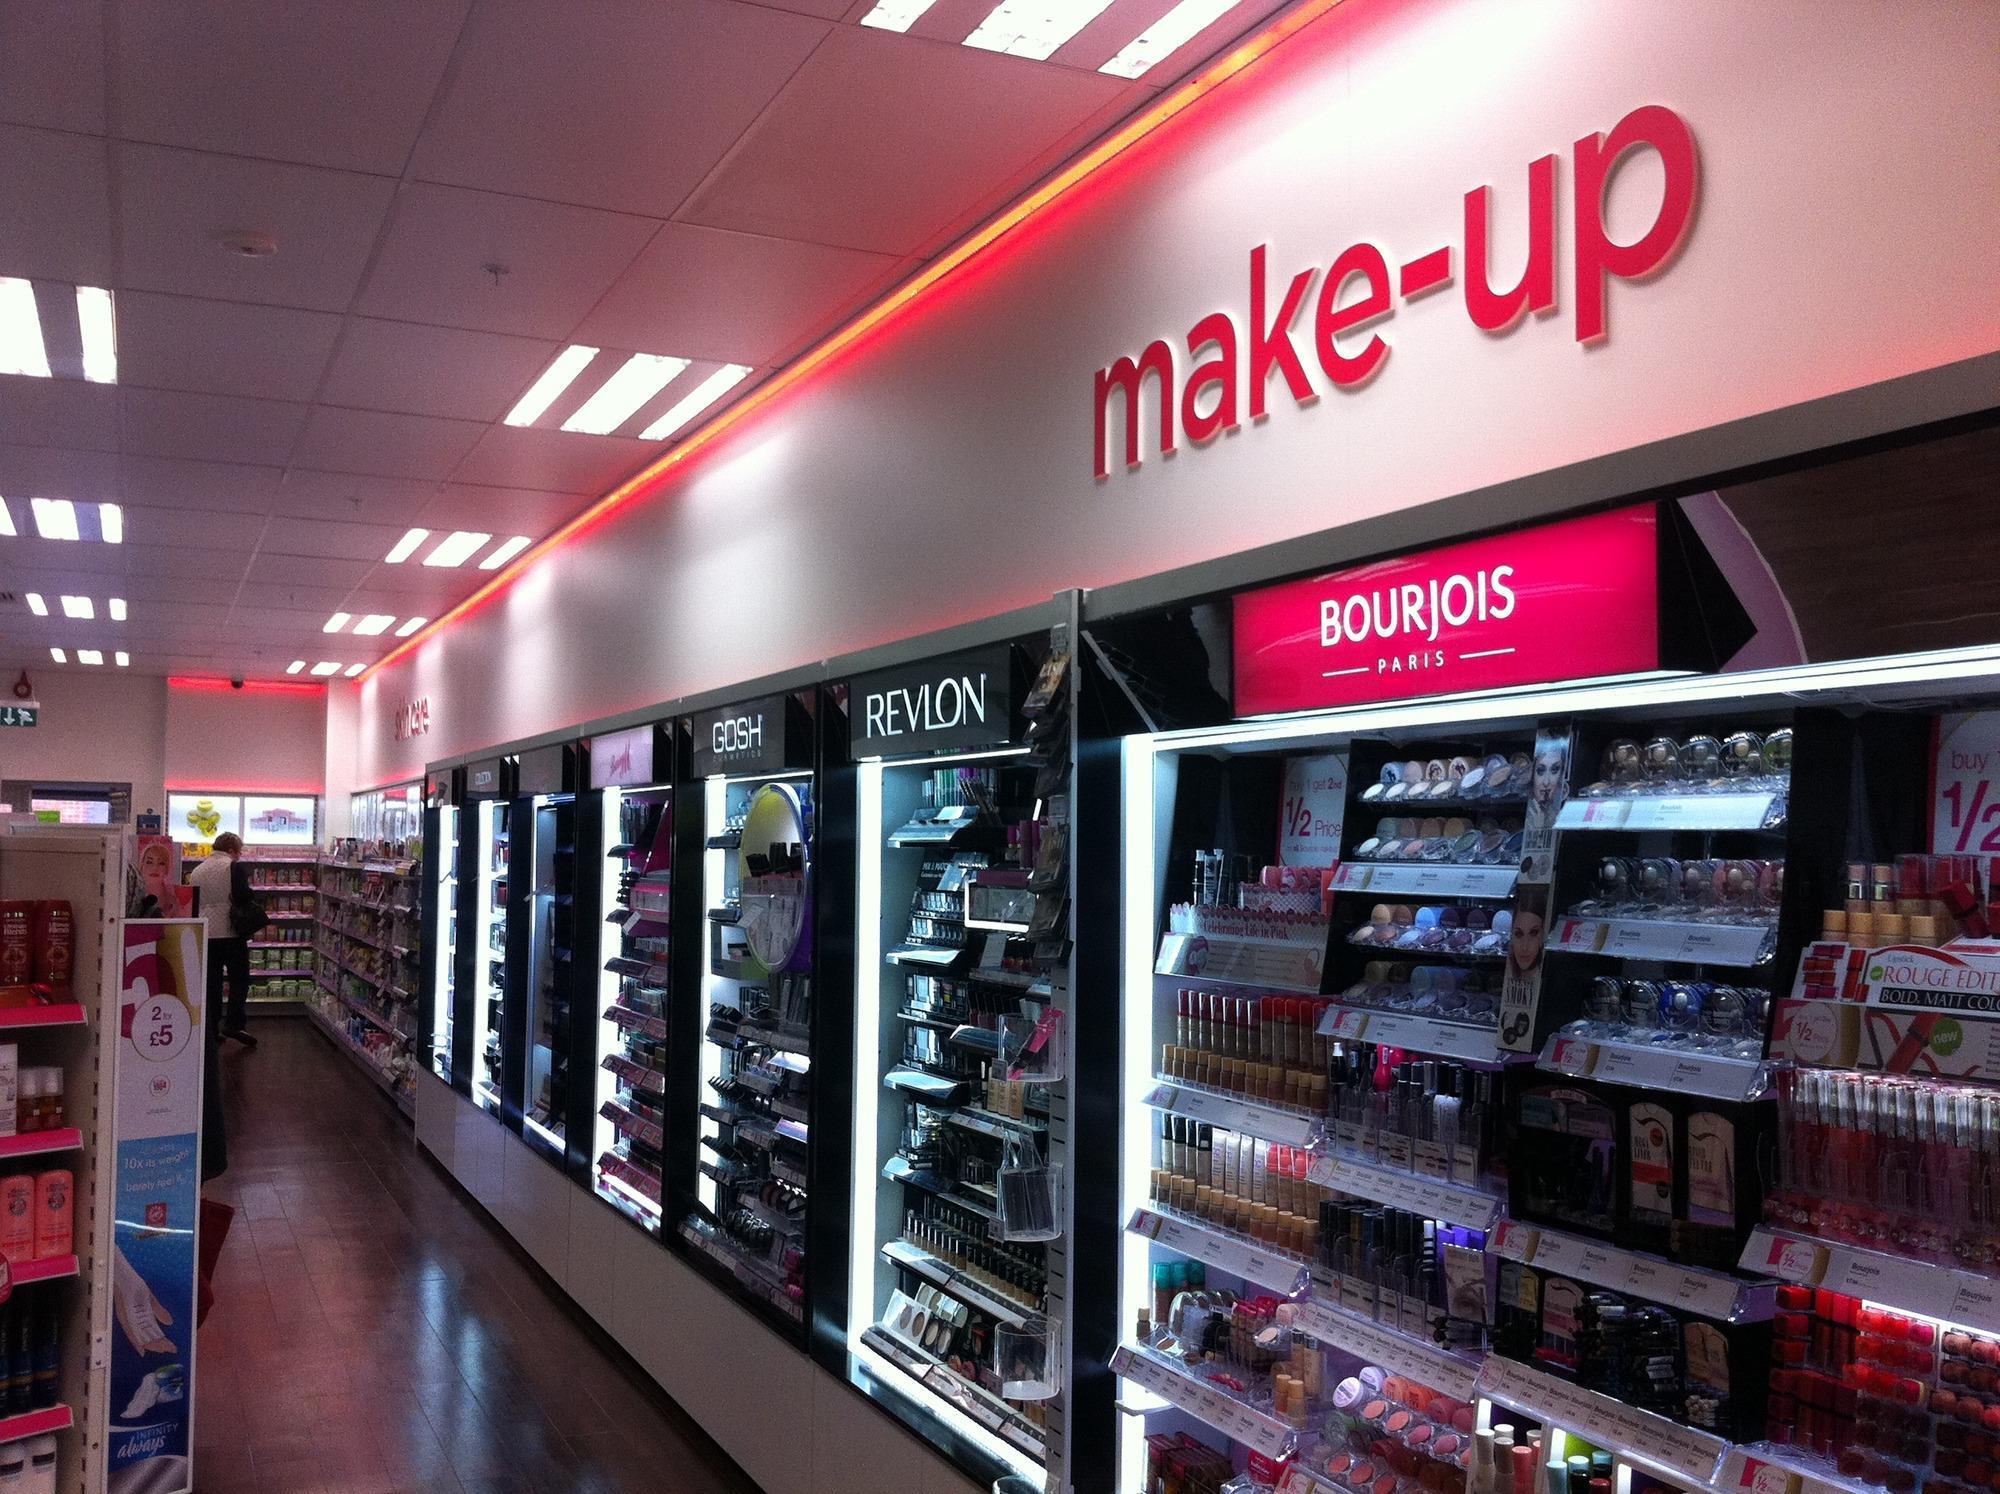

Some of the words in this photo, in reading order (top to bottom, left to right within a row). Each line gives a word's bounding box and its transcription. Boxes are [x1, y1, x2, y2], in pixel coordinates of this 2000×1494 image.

[1093, 104, 1701, 481] make-up
[1320, 565, 1515, 647] BOURJOIS
[1378, 650, 1444, 674] PARIS
[866, 673, 985, 738] REVLON
[713, 714, 762, 753] GOSH
[1951, 751, 1988, 773] buy
[1327, 778, 1342, 790] 2nd
[1286, 797, 1312, 837] 1/2
[1315, 820, 1341, 837] Price
[1883, 965, 1953, 988] ROUGE
[1924, 990, 1963, 1008] MATT
[1967, 994, 2000, 1012] COL
[151, 1006, 161, 1021] 2
[150, 1024, 173, 1046] £5
[1933, 1031, 1958, 1042] new
[117, 1435, 167, 1459] always
